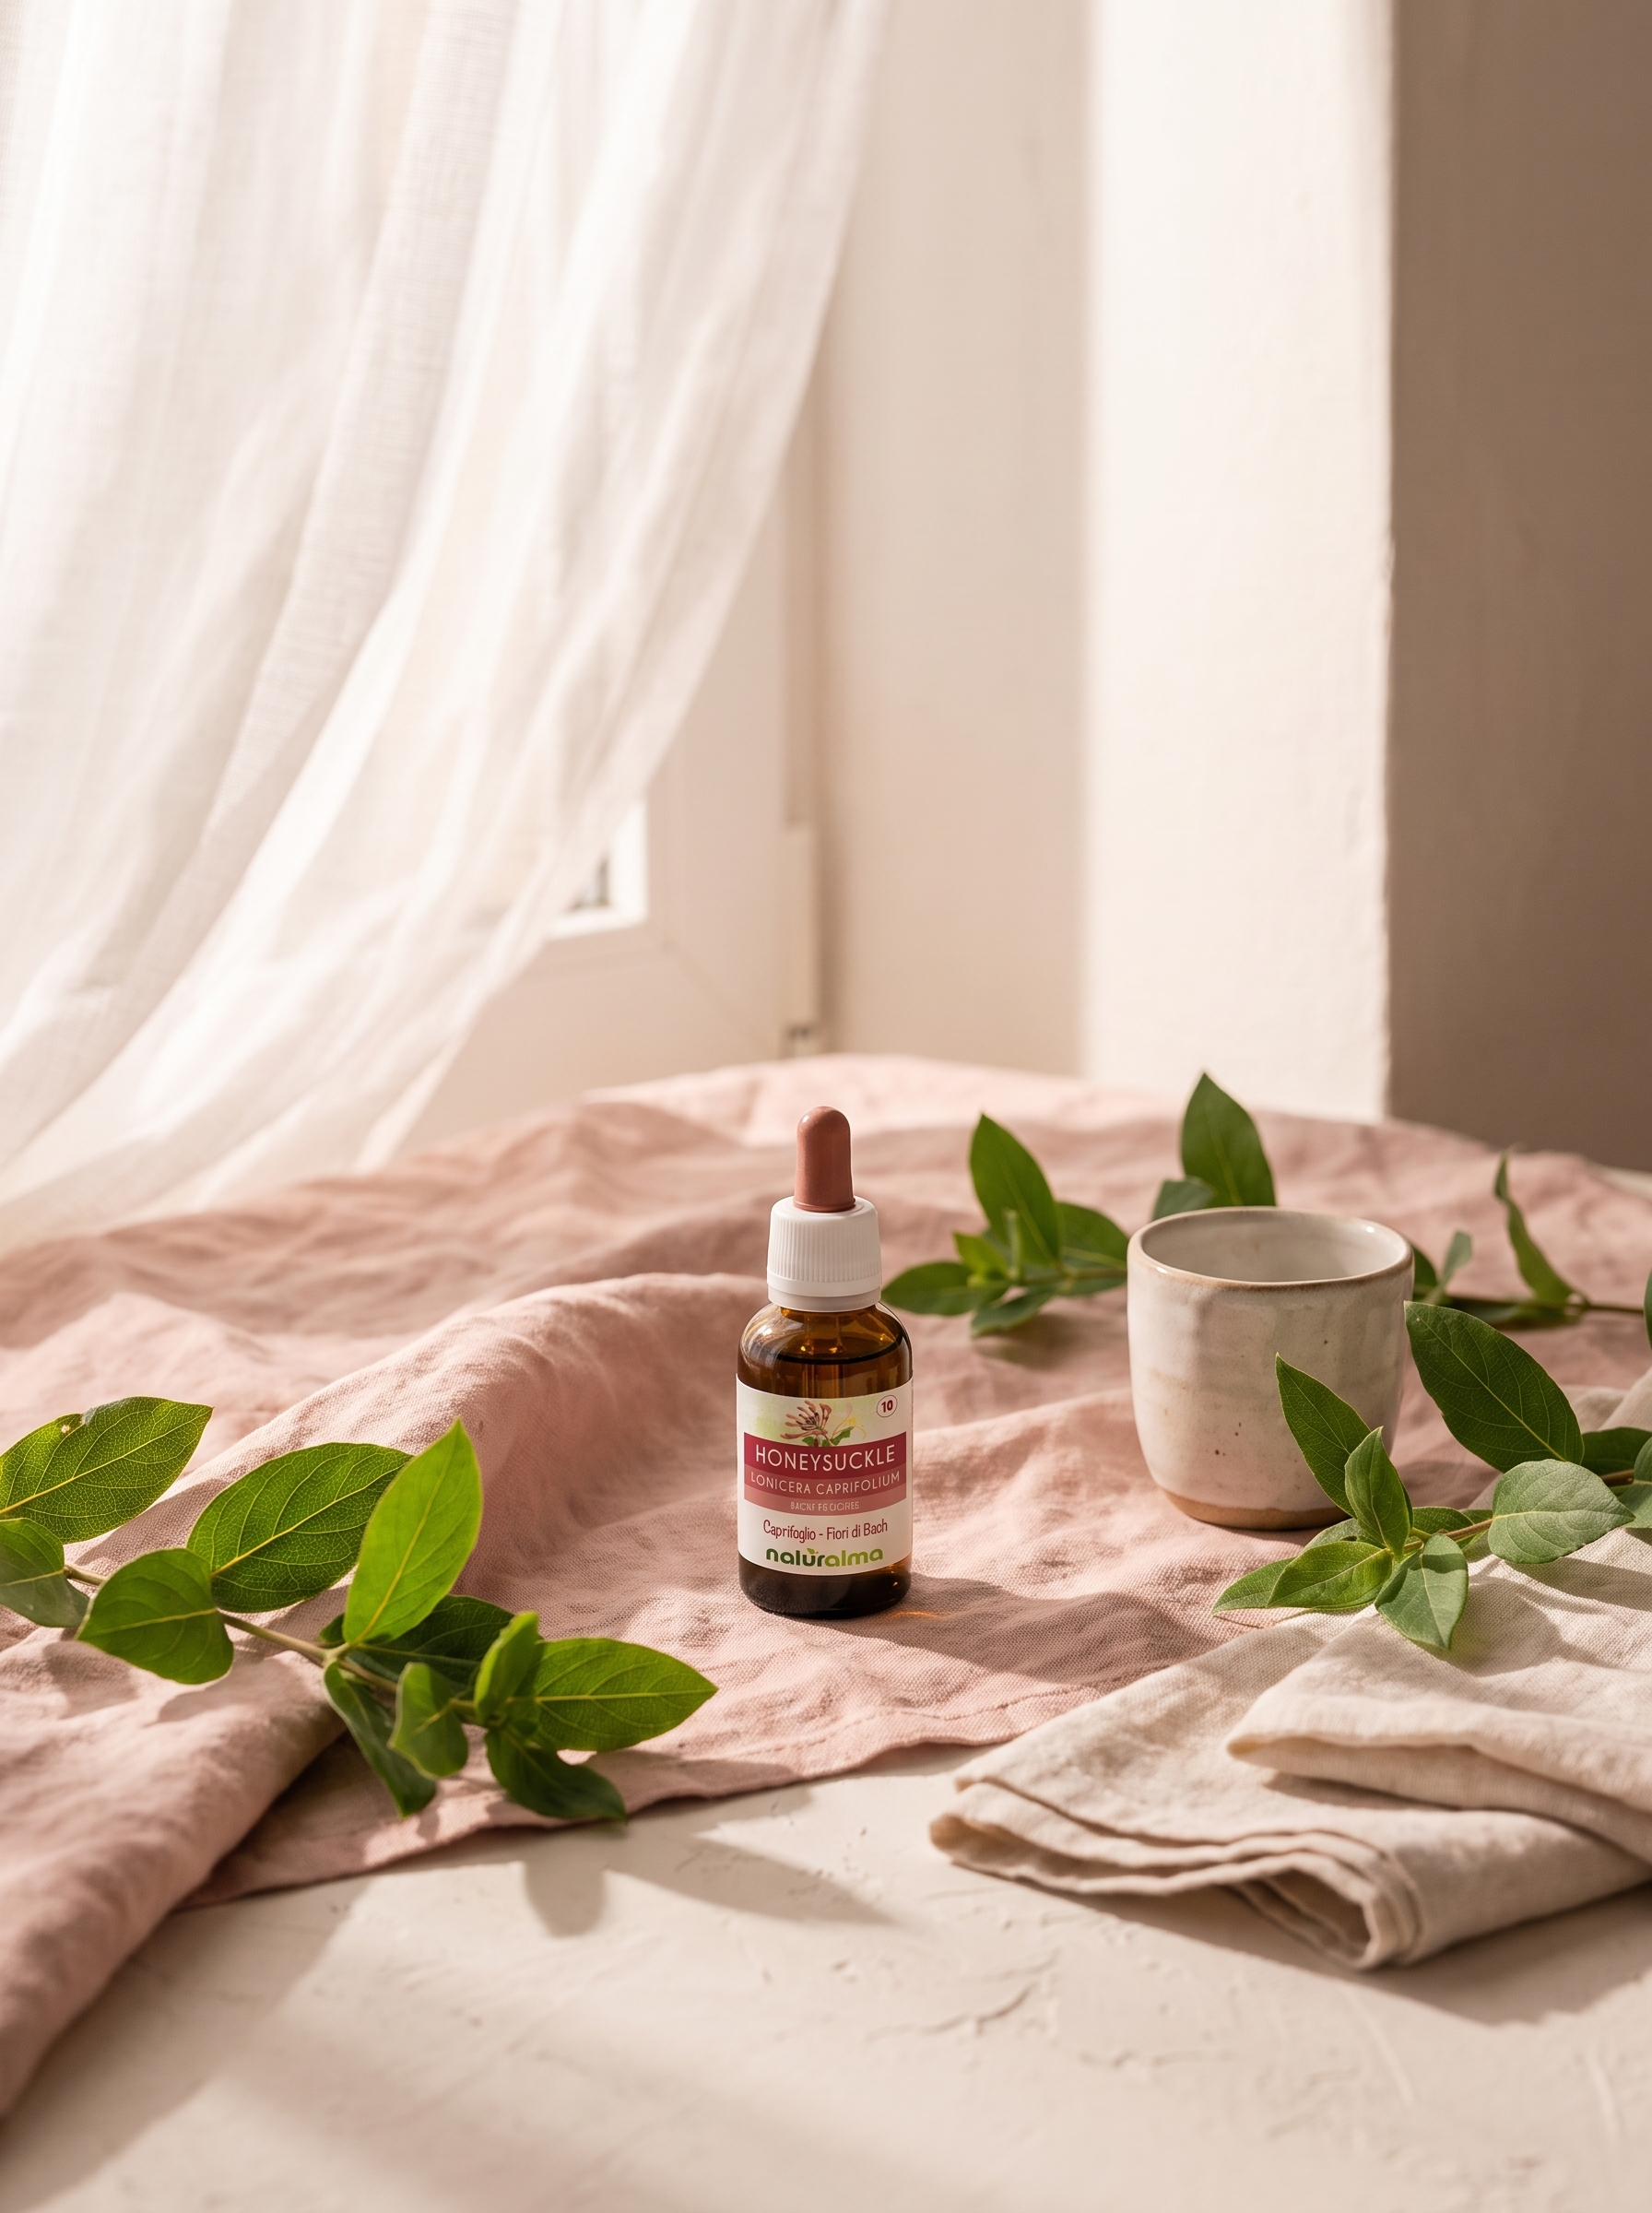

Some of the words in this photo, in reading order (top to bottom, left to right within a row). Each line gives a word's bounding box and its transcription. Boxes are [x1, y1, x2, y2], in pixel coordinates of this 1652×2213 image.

[880, 1399, 893, 1413] 10
[755, 1444, 895, 1472] HONEYSUCKLE
[750, 1471, 811, 1494] LONICERA
[816, 1471, 900, 1495] CAPRIFOLIUM
[762, 1519, 816, 1544] Caprifoglio
[826, 1526, 849, 1541] Fiori
[851, 1524, 861, 1538] di
[863, 1518, 888, 1536] Bach
